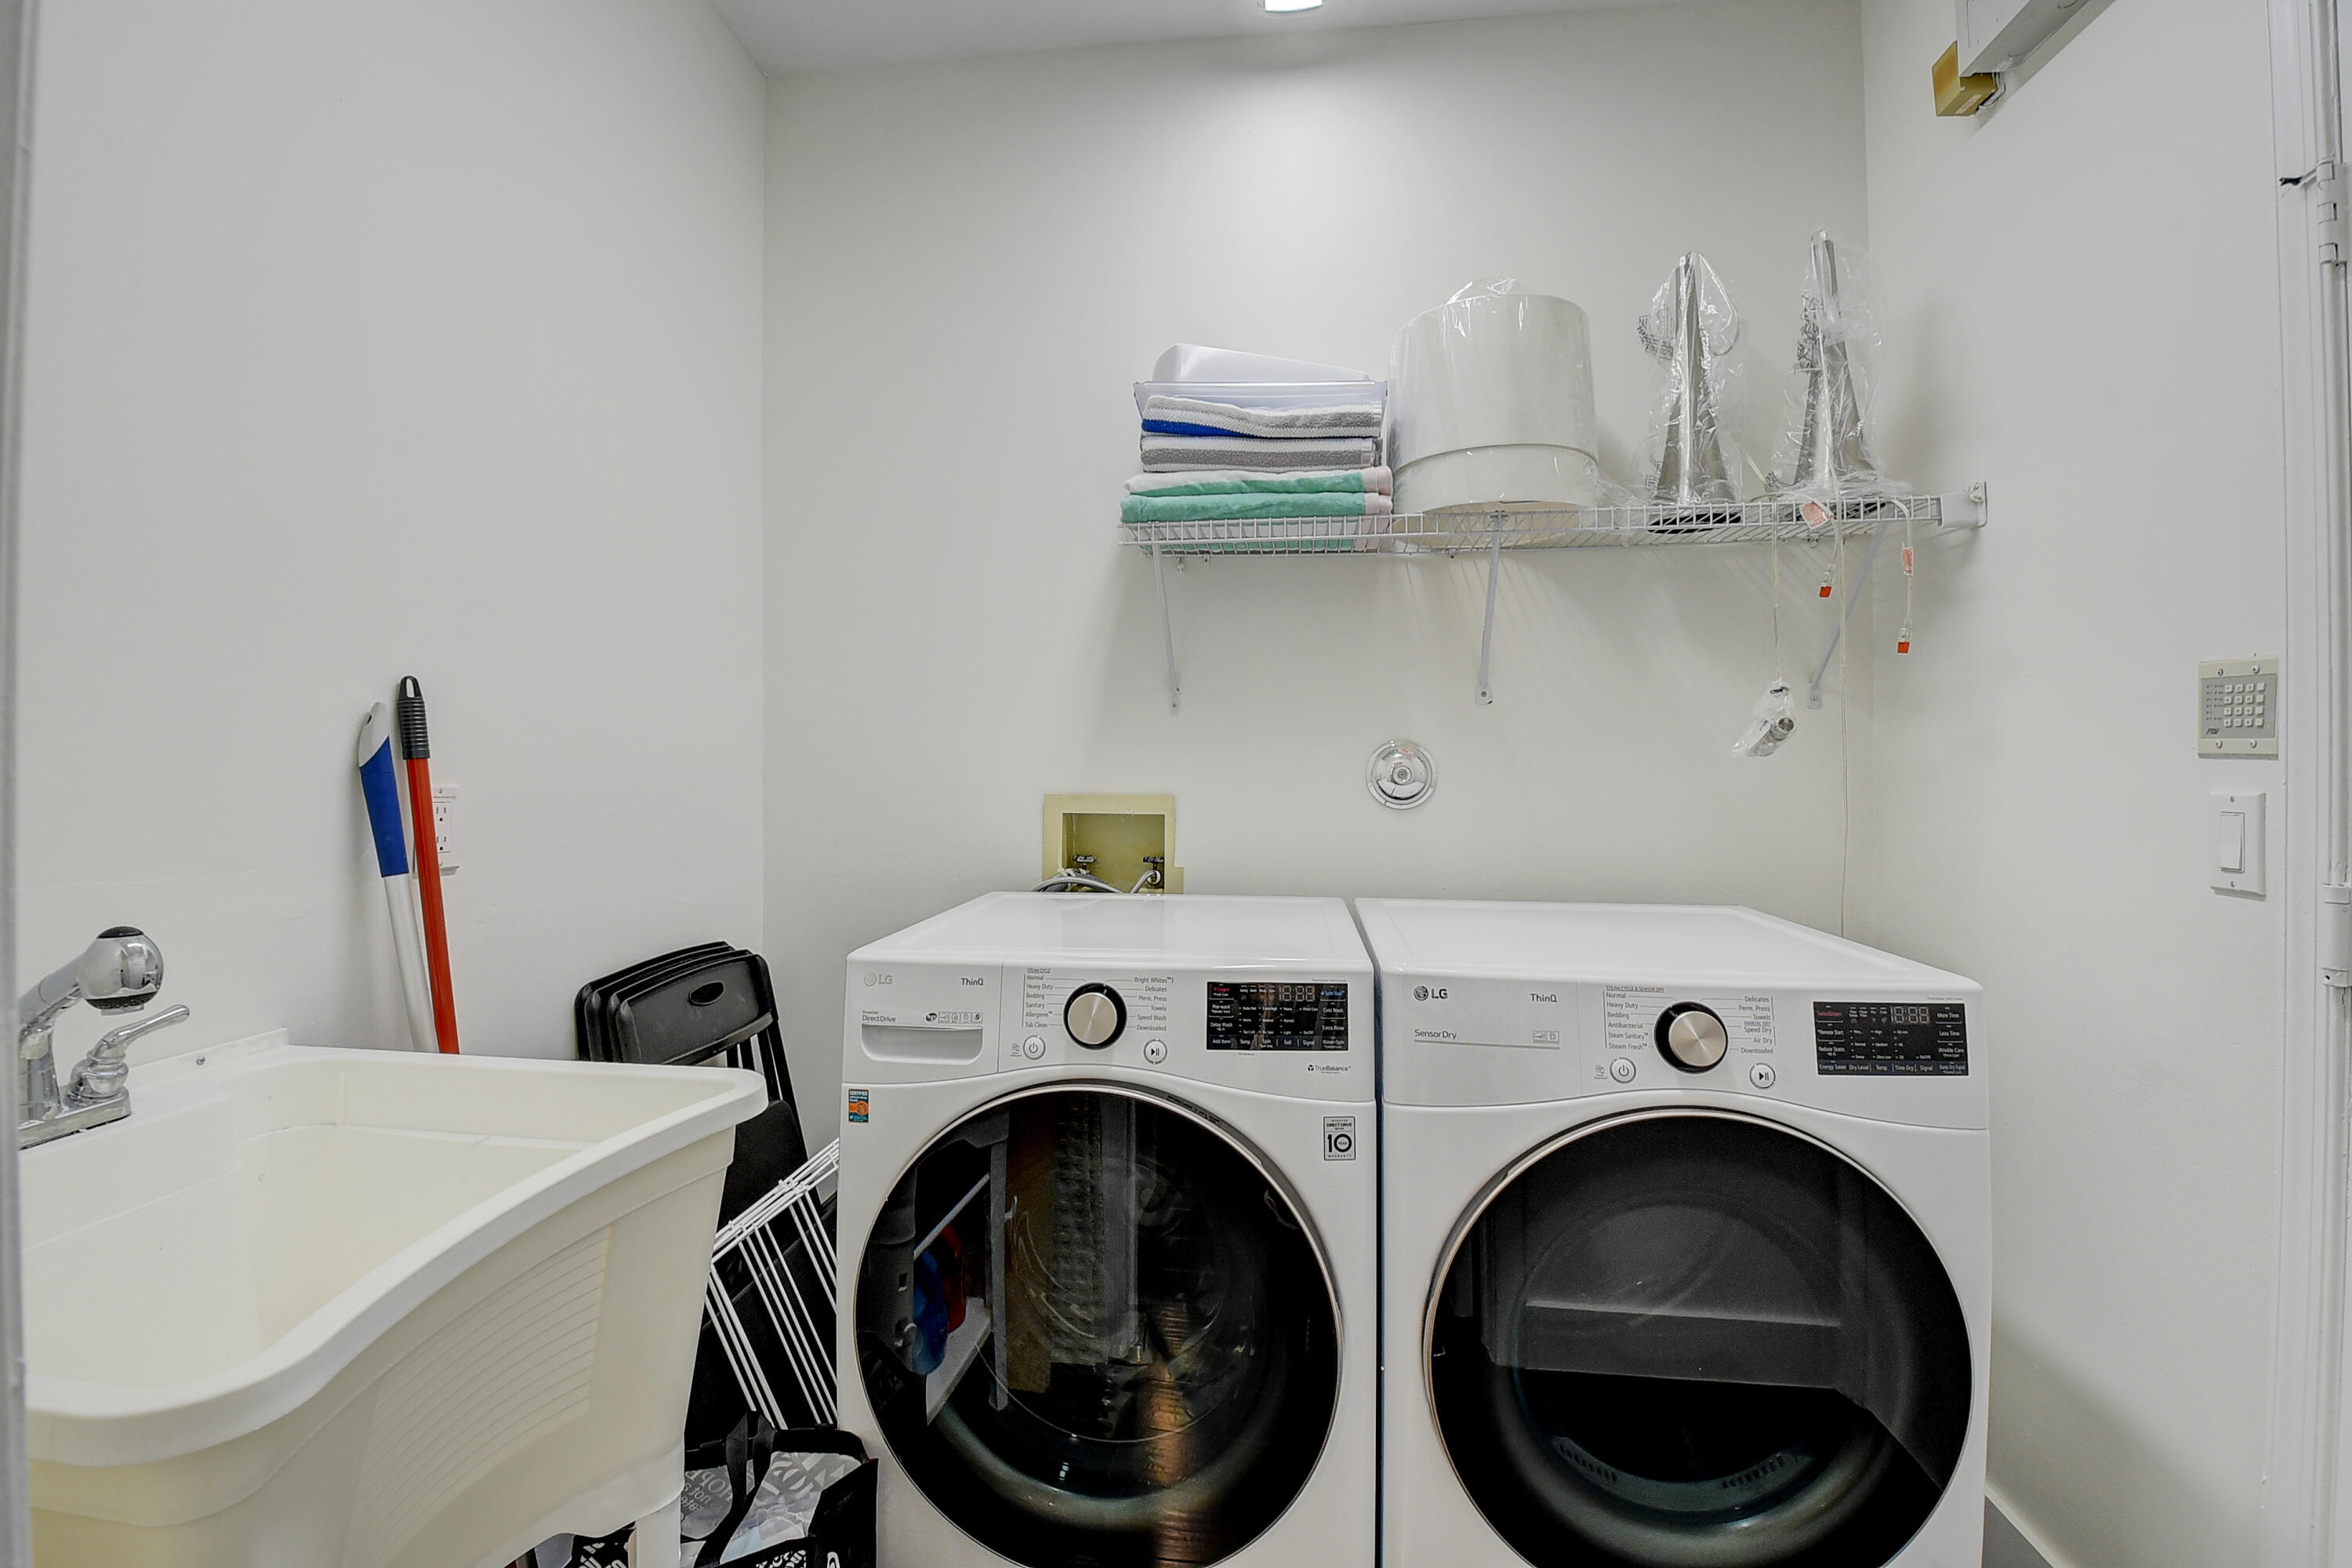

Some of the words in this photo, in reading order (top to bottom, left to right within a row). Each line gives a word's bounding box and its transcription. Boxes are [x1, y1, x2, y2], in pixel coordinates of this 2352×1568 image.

[878, 974, 893, 985] LG
[961, 978, 984, 986] ThinQ
[1432, 989, 1448, 999] LG
[1530, 993, 1557, 1003] ThinQ
[1762, 1037, 1773, 1046] Dry
[1327, 1134, 1352, 1152] 10
